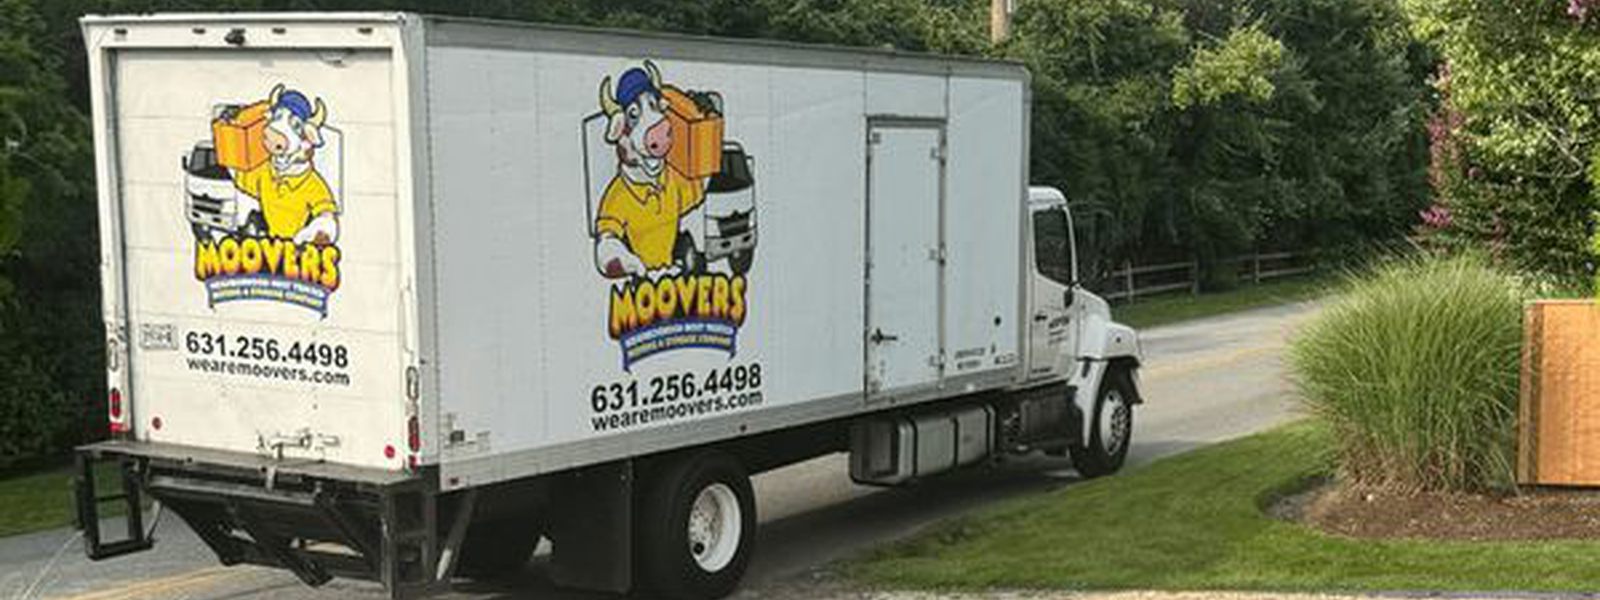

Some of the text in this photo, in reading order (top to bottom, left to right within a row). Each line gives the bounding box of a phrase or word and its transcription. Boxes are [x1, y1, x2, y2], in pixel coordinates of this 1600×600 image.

[196, 238, 341, 292] MOOVERS
[609, 273, 747, 340] MOOVERS
[186, 331, 349, 368] 631.256.4498
[186, 358, 350, 385] wearemoovers.com
[591, 363, 762, 412] 631.256.4498
[592, 391, 764, 431] wearemoovers.com
